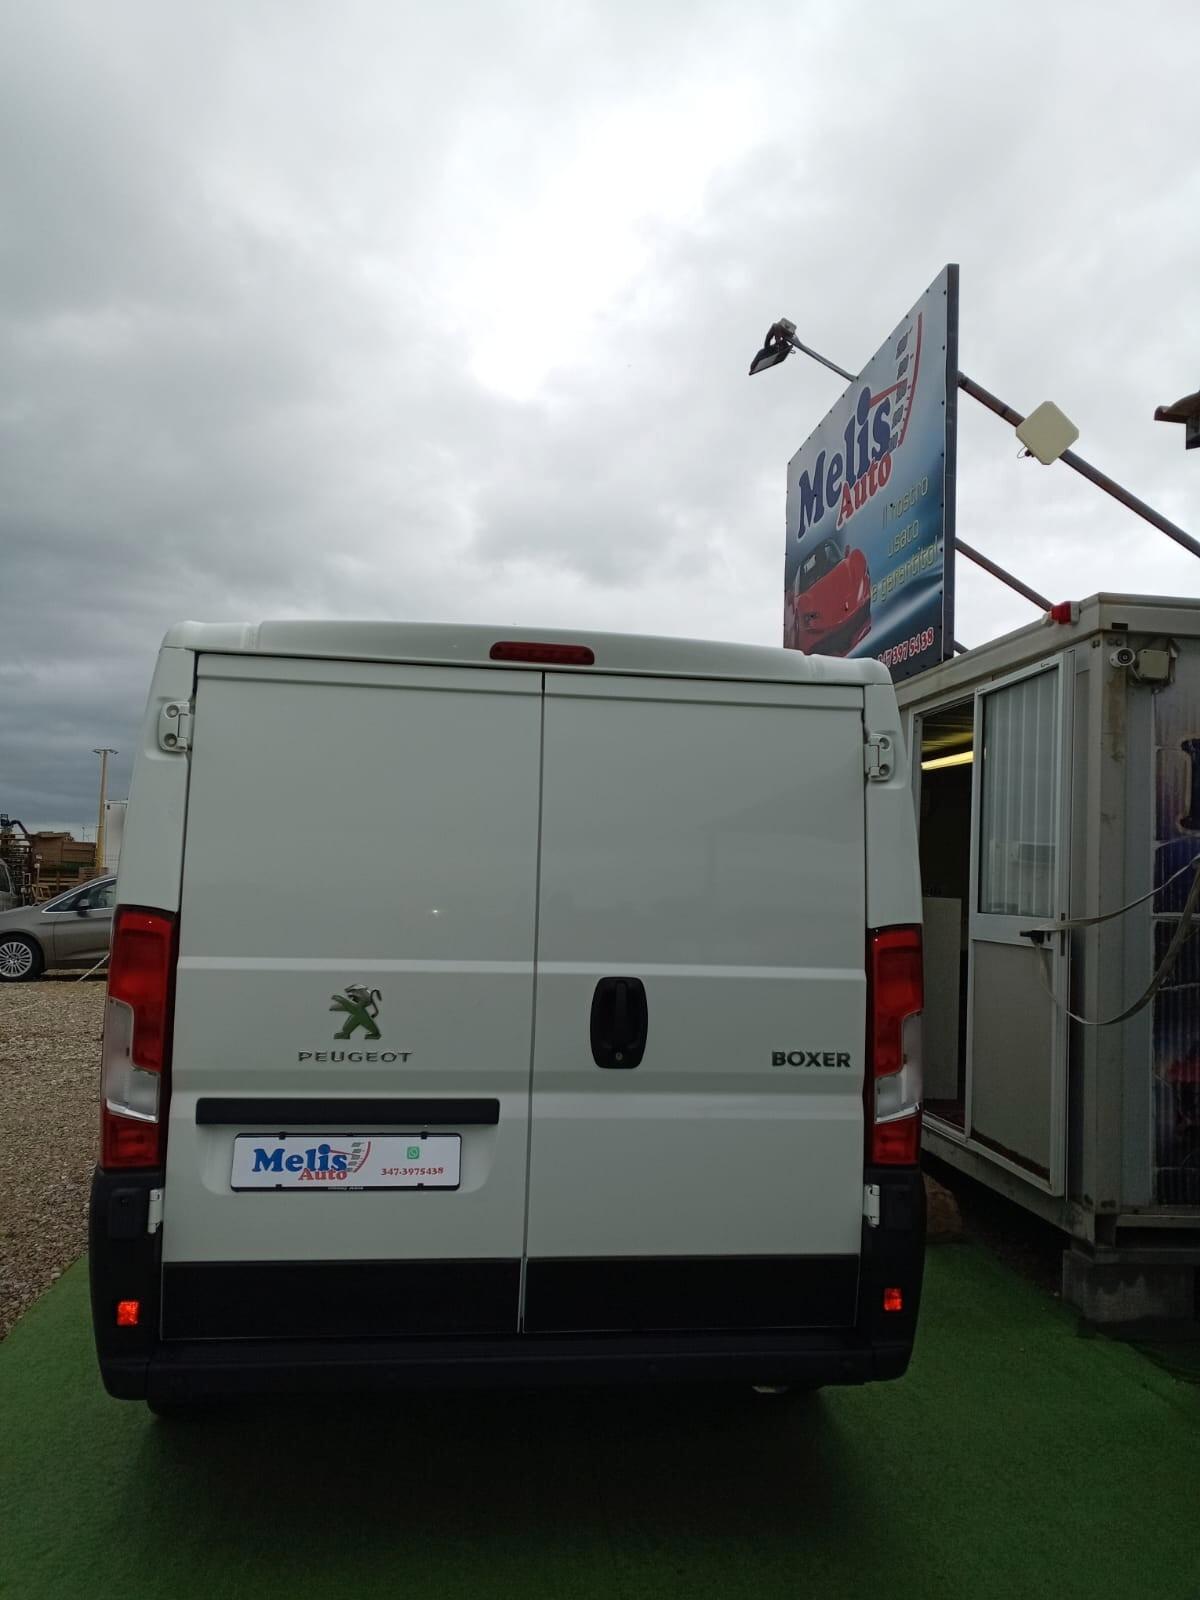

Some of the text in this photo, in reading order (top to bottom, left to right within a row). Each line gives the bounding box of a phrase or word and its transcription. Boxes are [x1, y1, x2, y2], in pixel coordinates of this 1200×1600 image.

[798, 386, 891, 539] Melis
[836, 450, 892, 529] Auto
[298, 1051, 412, 1063] PEUGEOT
[771, 1051, 851, 1068] BOXER
[252, 1143, 347, 1172] Melis
[298, 1167, 348, 1181] Auto
